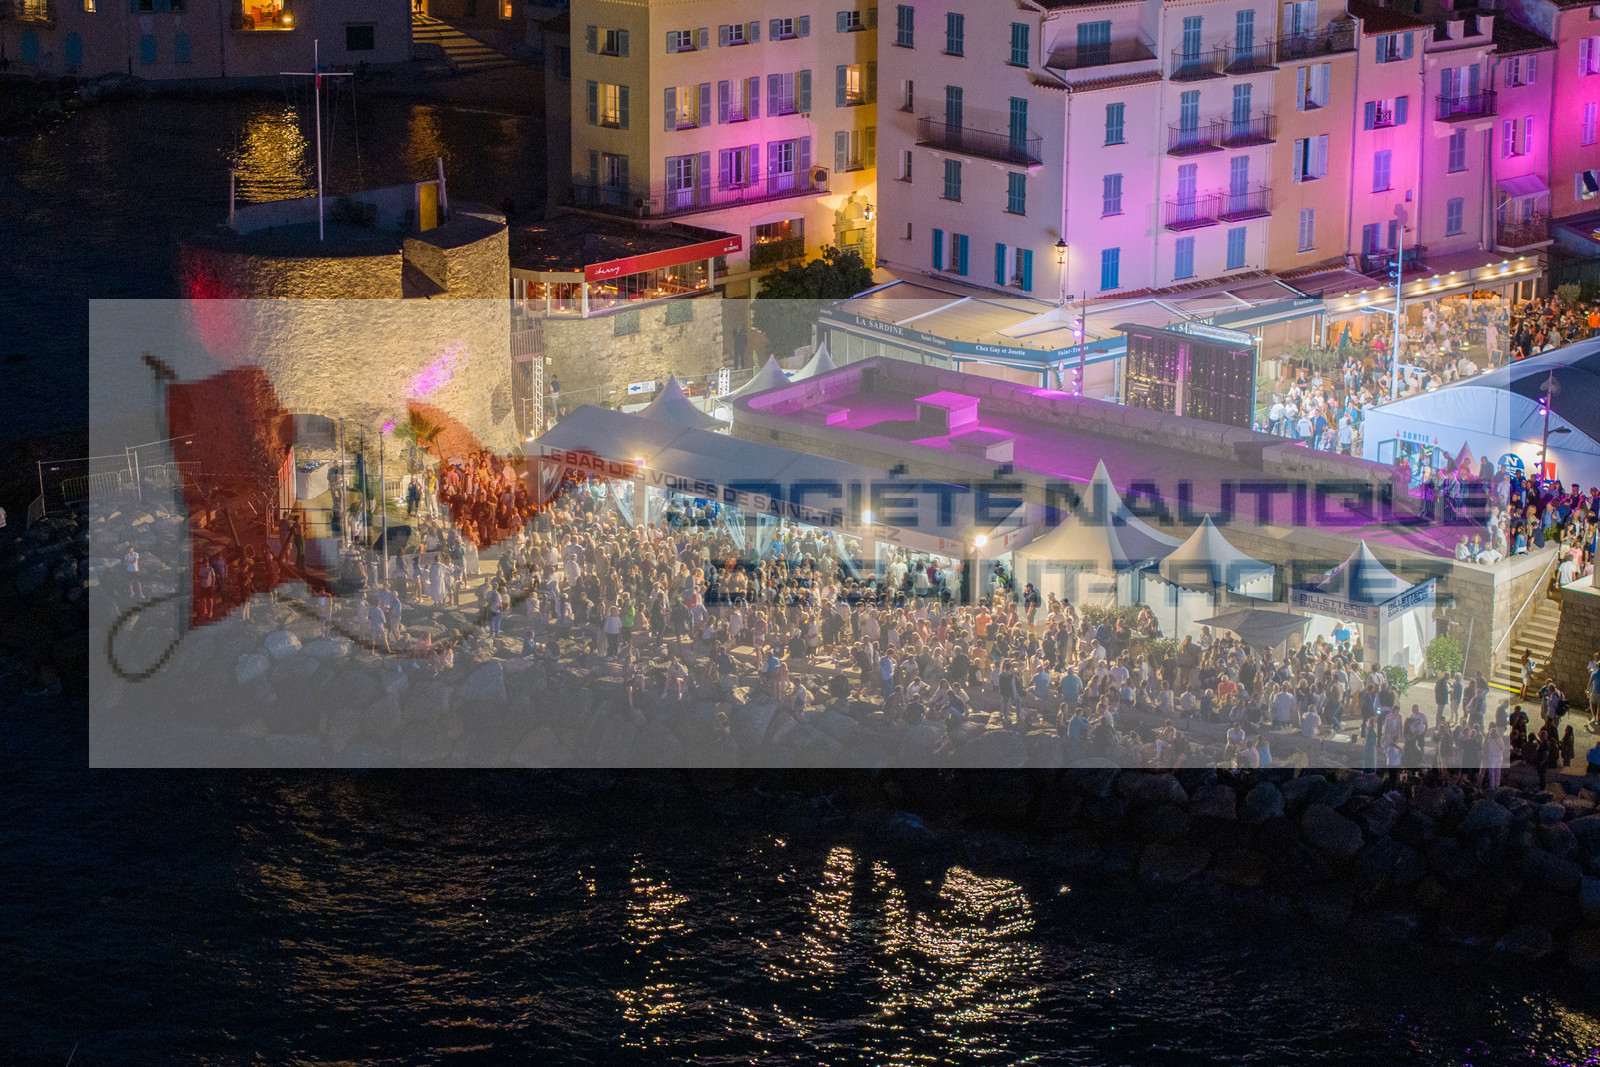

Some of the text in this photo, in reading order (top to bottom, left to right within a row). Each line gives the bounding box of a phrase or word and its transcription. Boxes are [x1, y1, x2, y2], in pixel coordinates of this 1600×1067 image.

[856, 317, 904, 336] LA SARDINE
[989, 346, 1001, 354] Guy
[1008, 348, 1026, 356] Josette
[1402, 431, 1429, 443] SORTIE
[1505, 456, 1519, 467] N
[541, 445, 561, 461] LE
[566, 450, 604, 471] BAR
[609, 461, 646, 481] DES
[651, 470, 718, 498] VOILES
[723, 487, 749, 507] DE
[1300, 594, 1368, 614] BILLETTERIE
[1387, 584, 1429, 612] BILLETTERIE
[1387, 593, 1429, 617] BAR DES VOILES
[1300, 601, 1368, 620] BAR DES VOILES
